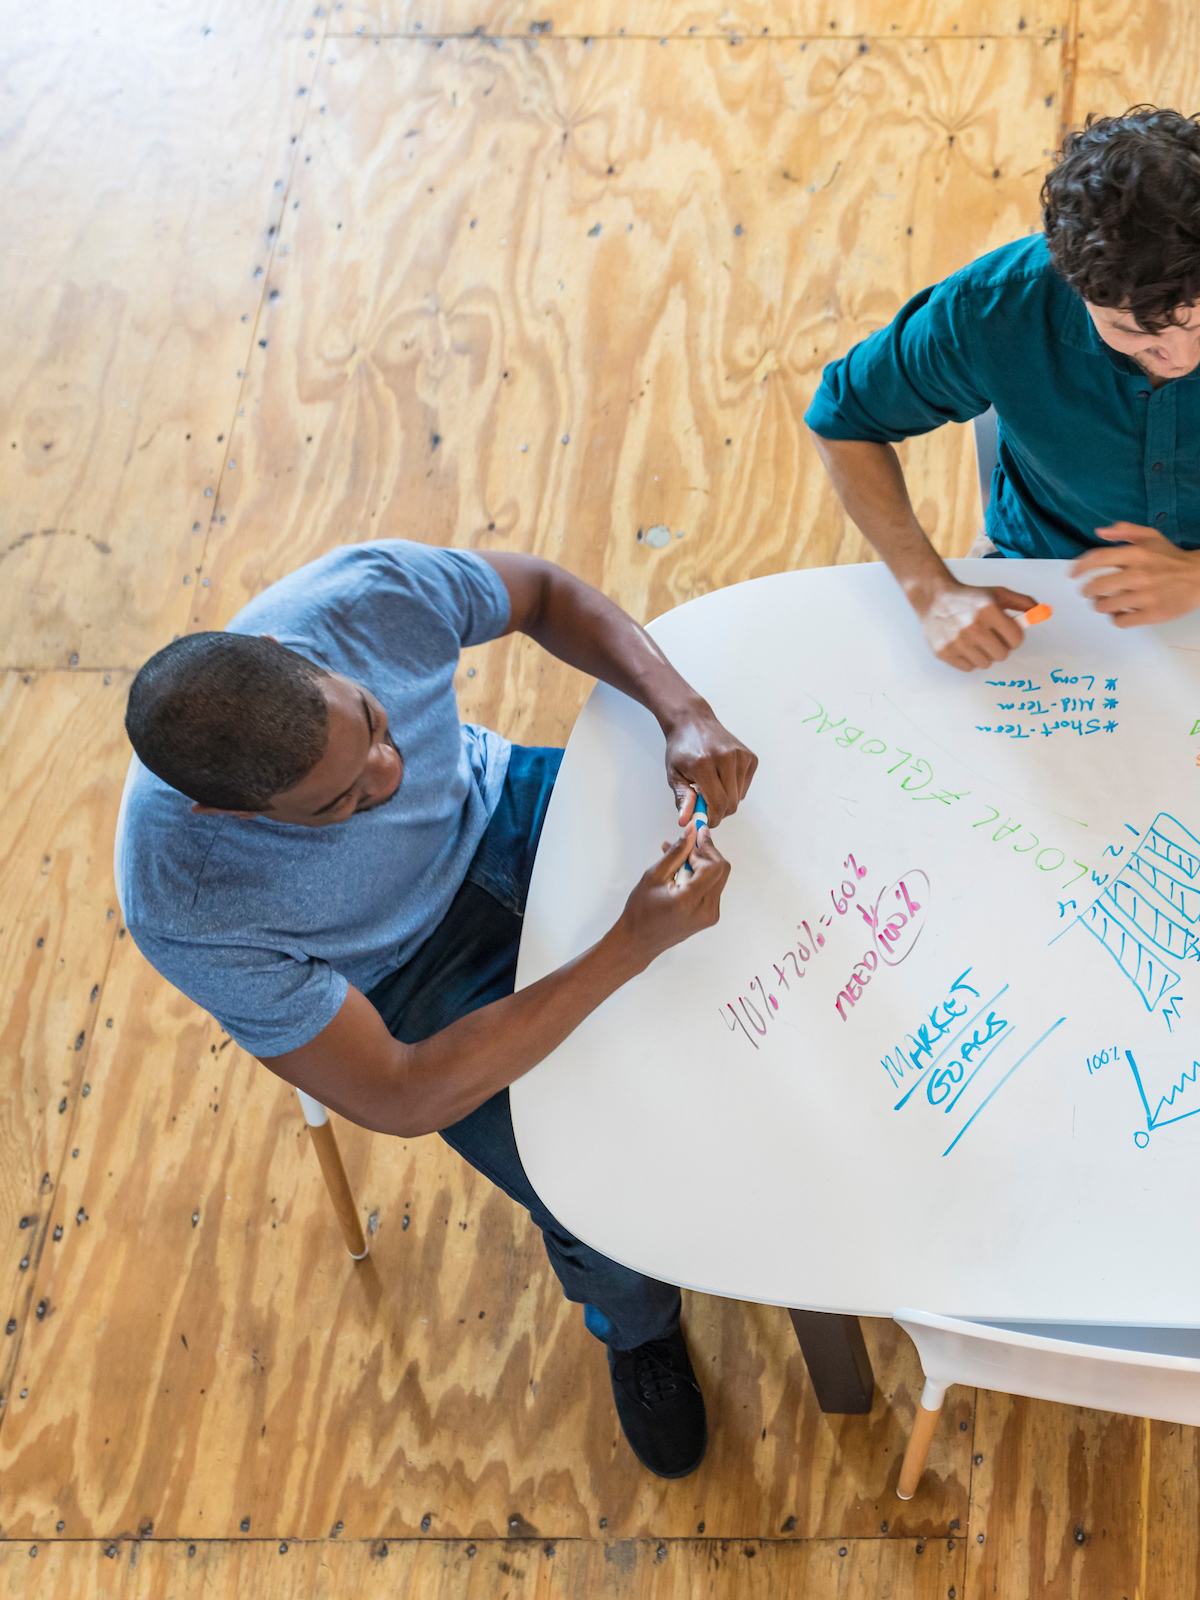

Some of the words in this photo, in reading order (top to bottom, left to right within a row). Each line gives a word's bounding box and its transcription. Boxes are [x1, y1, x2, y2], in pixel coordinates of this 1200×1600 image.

[985, 679, 1041, 692] Term
[1050, 669, 1095, 691] Long
[801, 690, 934, 791] GLOBAL
[972, 804, 1089, 889] LOCAL
[880, 966, 980, 1089] MARKET
[926, 1011, 1008, 1105] GOALS
[1086, 1046, 1120, 1074] 100%
